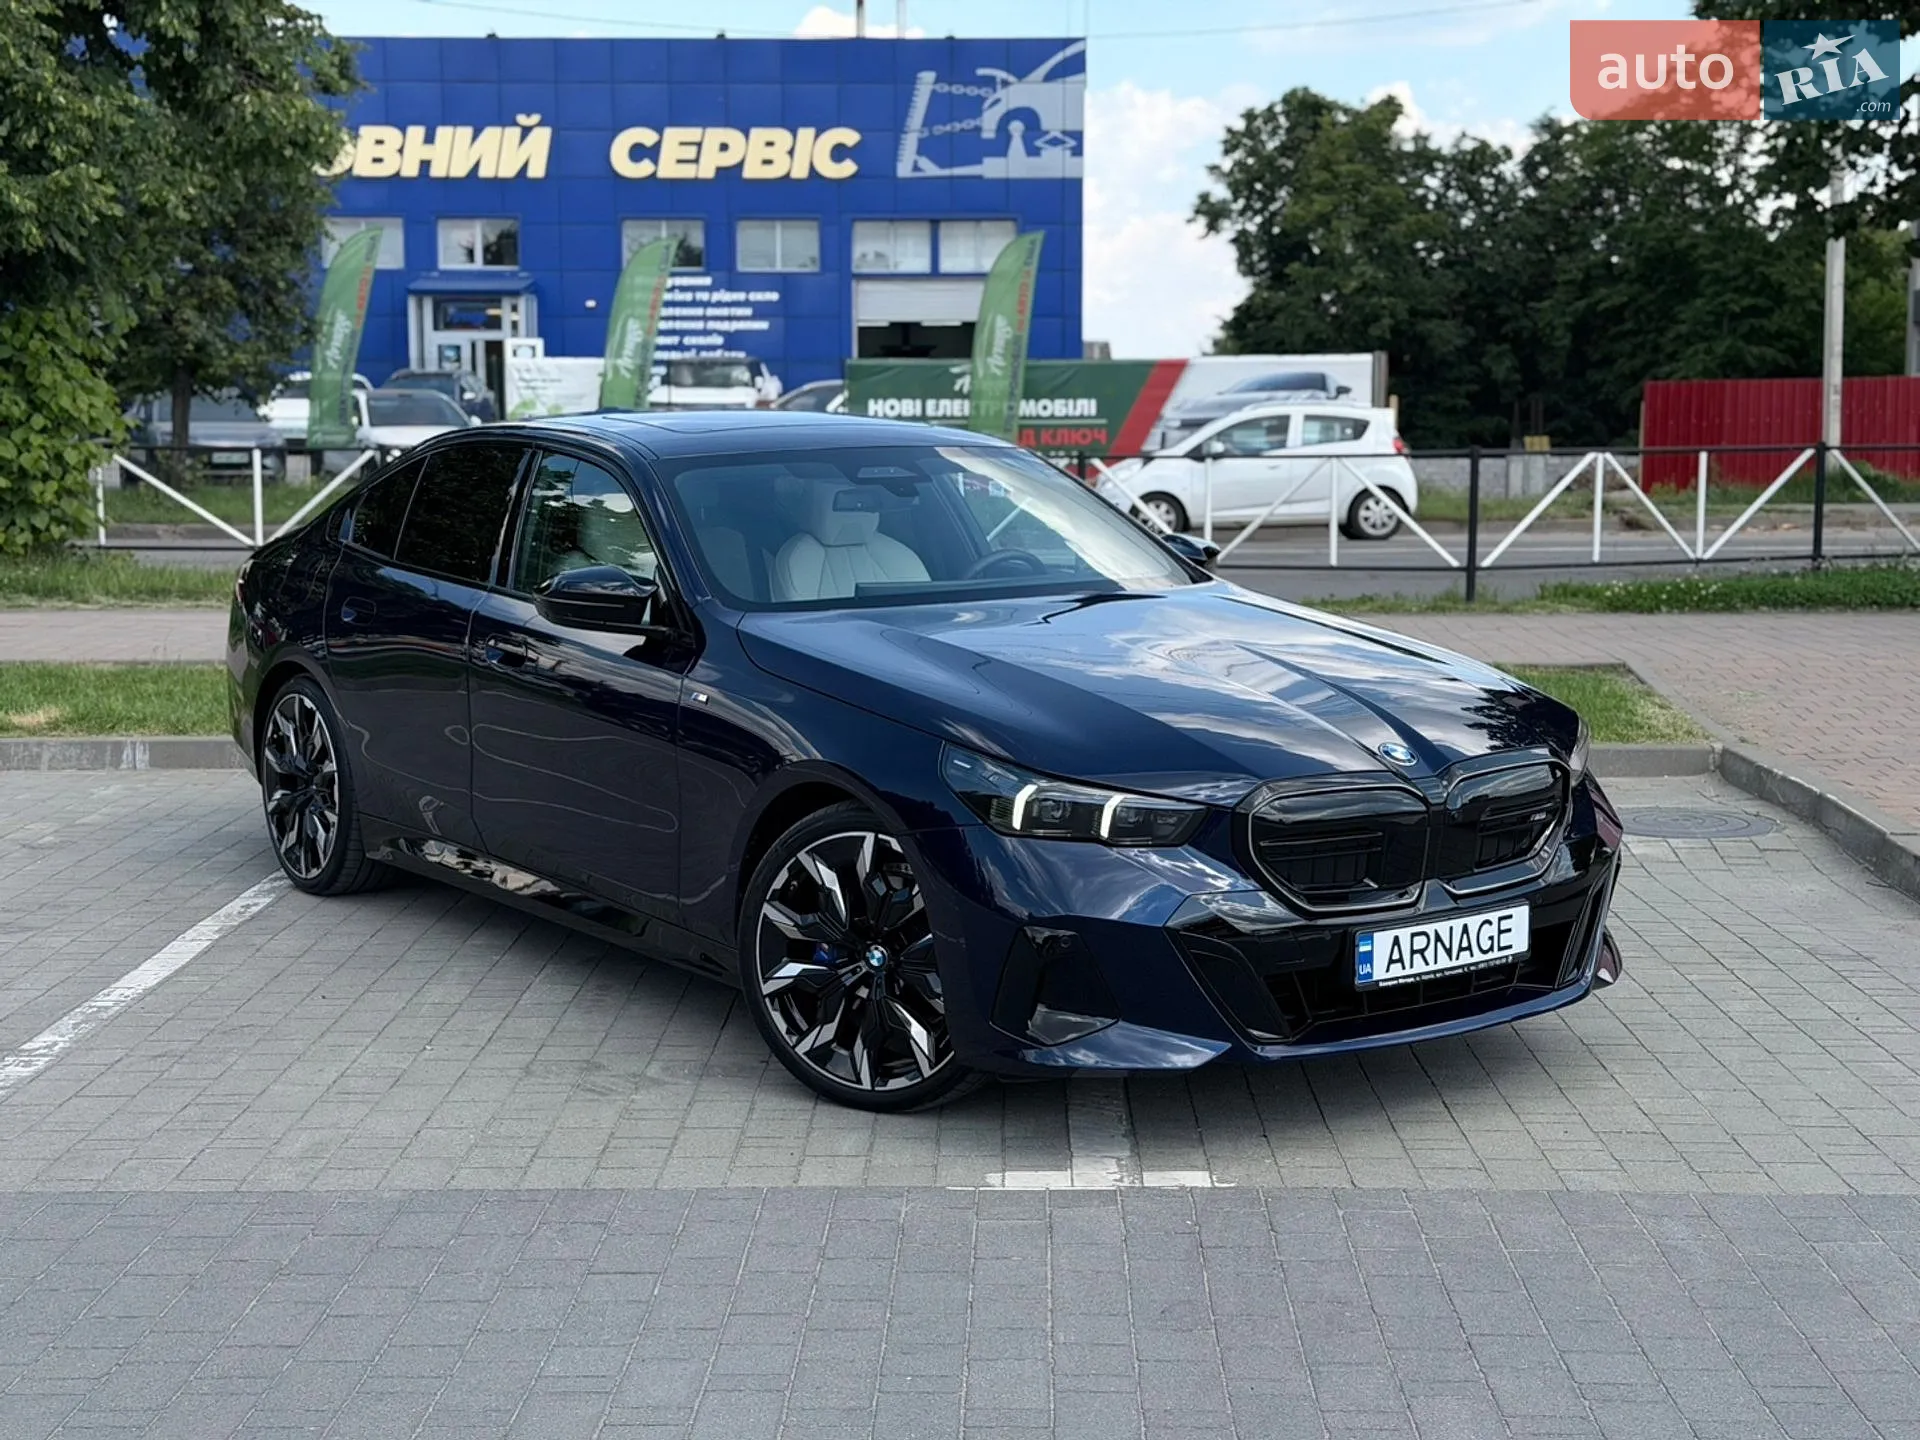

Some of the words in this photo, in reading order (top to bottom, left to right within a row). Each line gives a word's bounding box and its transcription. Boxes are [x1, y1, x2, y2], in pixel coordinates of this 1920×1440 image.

[609, 126, 862, 180] СЕРВІС
[868, 397, 922, 418] НОВІ
[924, 397, 1097, 418] ЕЛЕМОБІЛІ
[1041, 427, 1107, 447] КЛЮЧ
[1385, 914, 1514, 973] ARNAGE
[1359, 963, 1372, 975] UA
